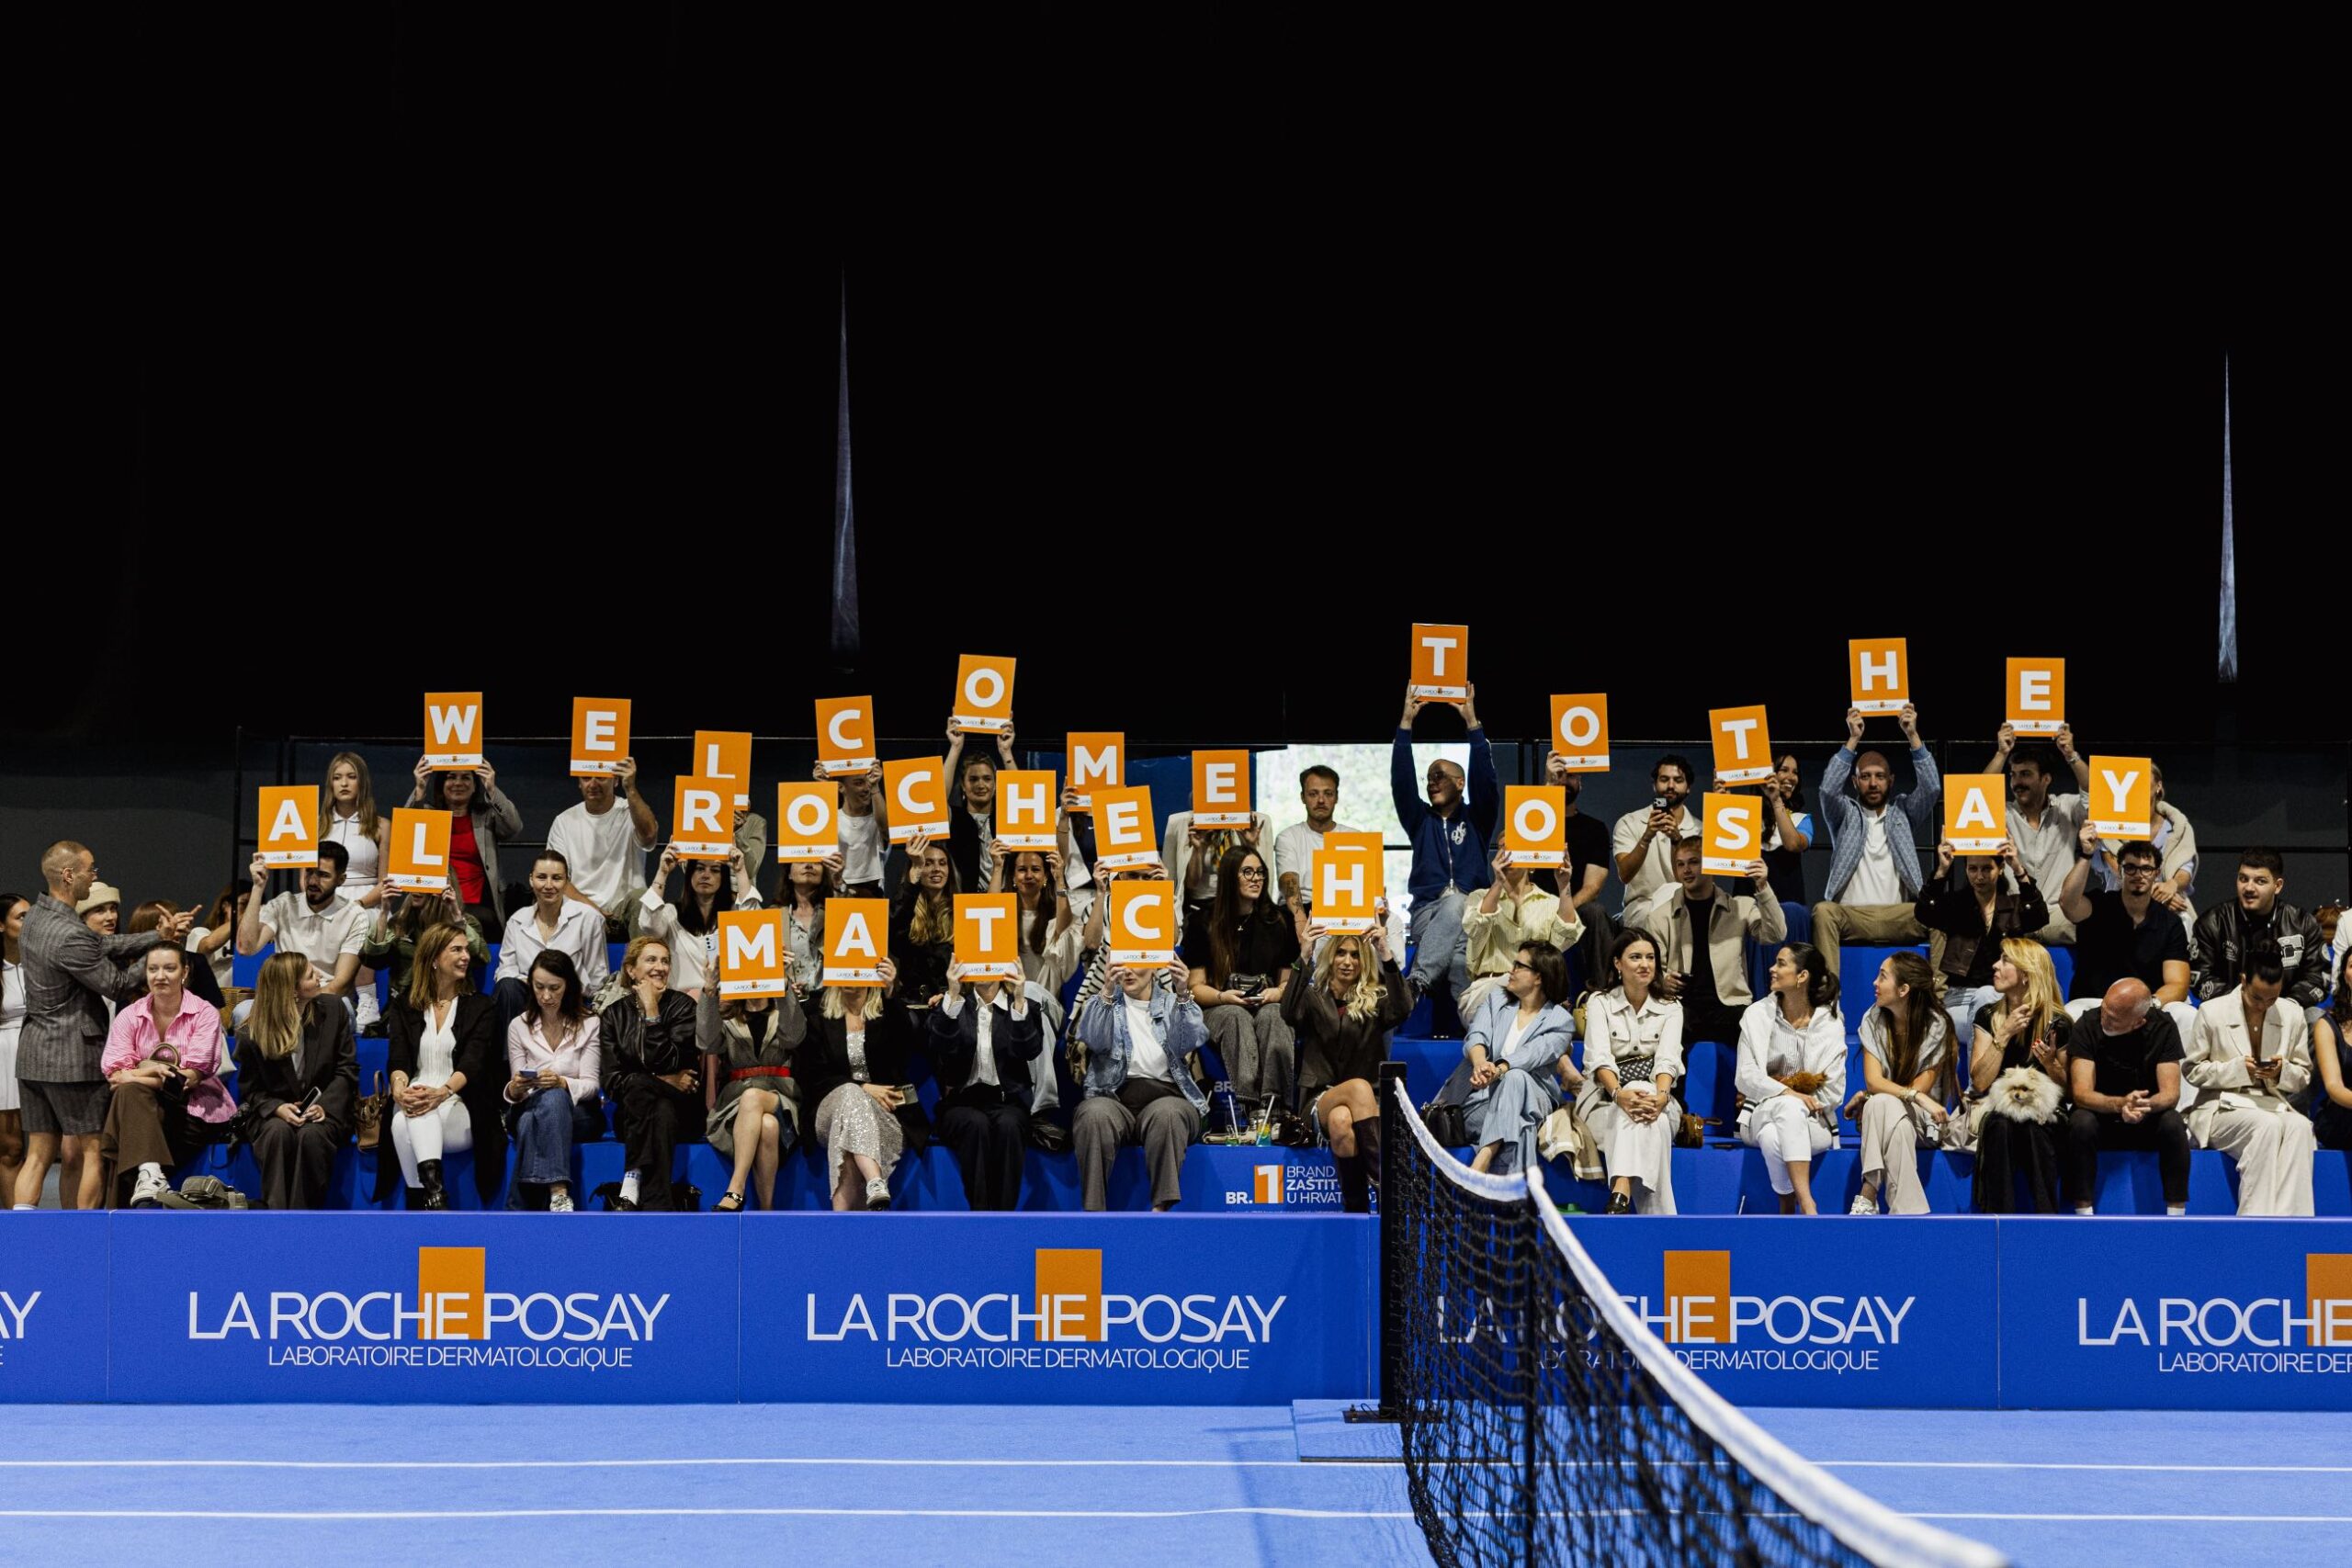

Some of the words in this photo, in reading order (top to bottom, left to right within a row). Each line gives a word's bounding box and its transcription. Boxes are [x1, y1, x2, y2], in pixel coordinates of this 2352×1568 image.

[1421, 637, 1457, 677] T
[1860, 650, 1899, 691] H
[964, 668, 1005, 708] O
[2019, 671, 2052, 711] E
[429, 705, 478, 745] W
[584, 710, 617, 751] E
[828, 709, 864, 750] C
[1560, 705, 1600, 747] O
[1721, 718, 1758, 760] T
[706, 743, 736, 779] L
[1074, 745, 1117, 785] M
[897, 770, 935, 814] C
[1205, 762, 1237, 803] E
[2101, 770, 2139, 813] Y
[268, 799, 308, 841] A
[682, 789, 723, 832] R
[786, 794, 830, 837] O
[1006, 783, 1046, 825] H
[1106, 801, 1142, 845] E
[1513, 799, 1556, 842] O
[1955, 787, 1996, 829] A
[412, 822, 443, 866] L
[1715, 807, 1750, 851] S
[1322, 863, 1364, 907] H
[834, 912, 877, 957] A
[965, 907, 1006, 952] T
[1123, 894, 1161, 940] C
[726, 923, 776, 970] M
[1226, 1191, 1253, 1204] BR.
[1257, 1165, 1280, 1204] 1
[1286, 1165, 1336, 1179] BRAND
[1286, 1176, 1341, 1191] ZAŠTIT
[1286, 1191, 1297, 1204] U
[188, 1291, 261, 1341] LA
[269, 1291, 470, 1342] ROCHE
[481, 1292, 671, 1342] POSAY
[807, 1292, 879, 1343] LA
[888, 1292, 1088, 1344] ROCHE
[1100, 1293, 1287, 1344] POSAY
[1729, 1295, 1917, 1345] POSAY
[2078, 1297, 2151, 1347] LA
[2159, 1297, 2352, 1348] ROCHE
[268, 1346, 424, 1368] LABORATOIRE
[427, 1346, 633, 1372] DERMATOLOGIQUE
[887, 1347, 1042, 1369] LABORATOIRE
[1045, 1347, 1250, 1373] DERMATOLOGIQUE
[1676, 1349, 1879, 1375] DERMATOLOGIQUE
[2159, 1352, 2313, 1373] LABORATOIRE
